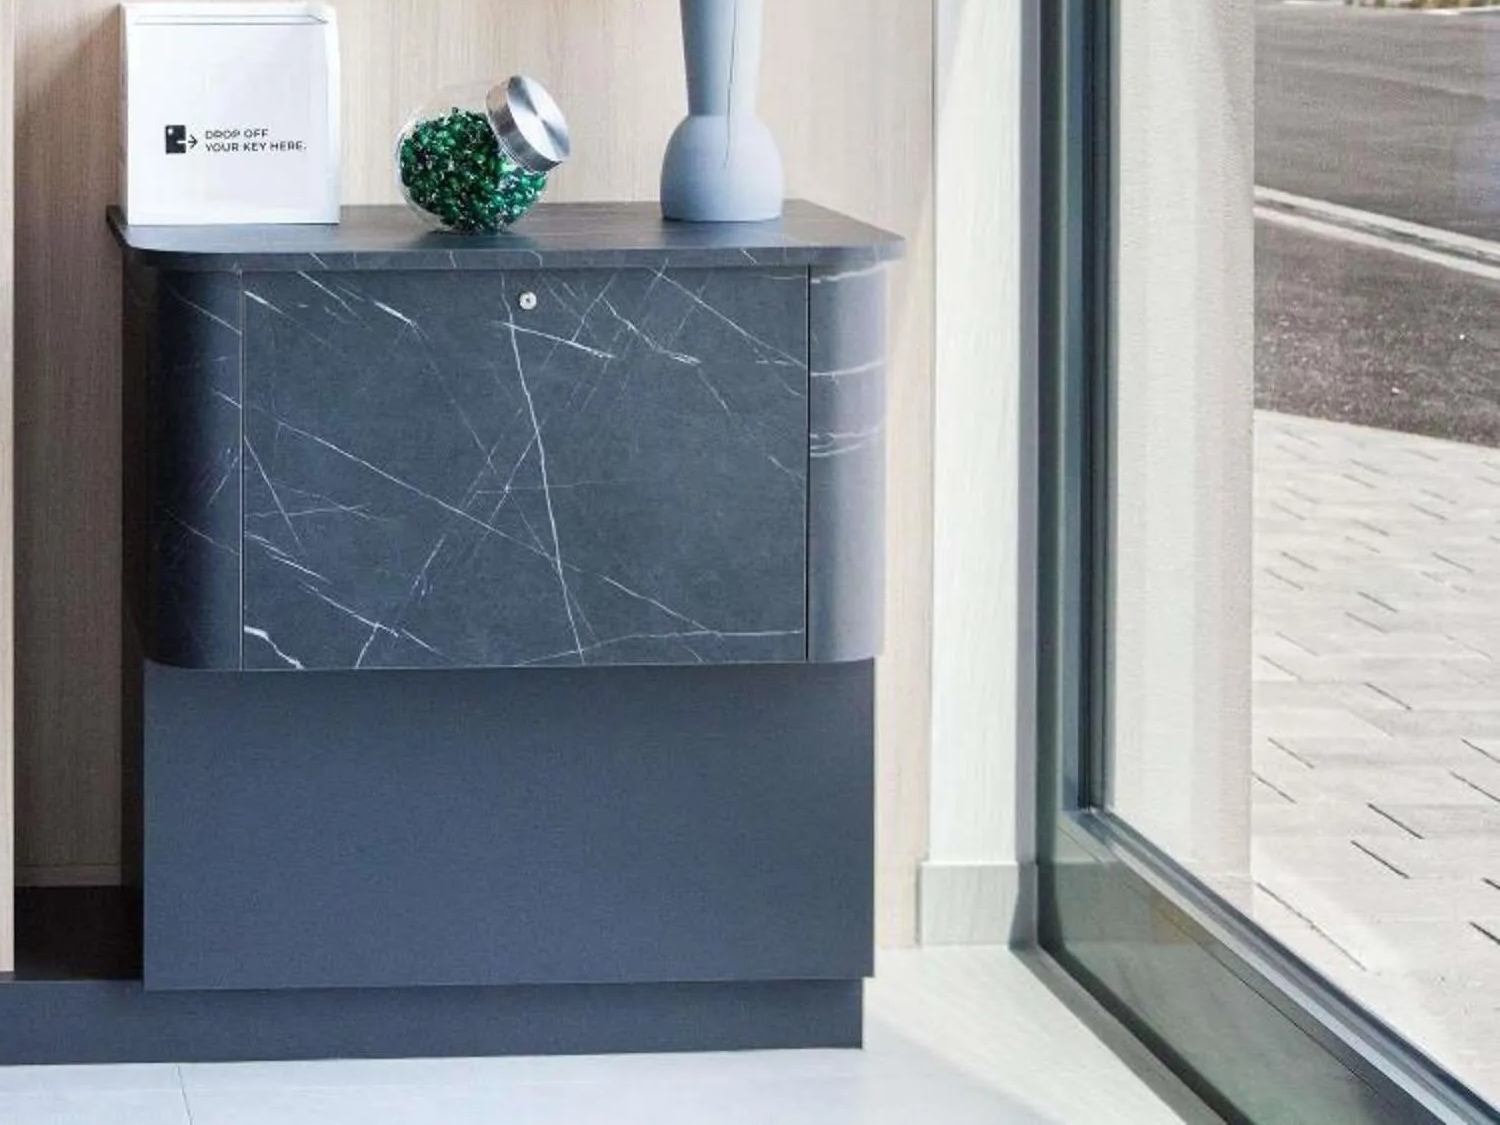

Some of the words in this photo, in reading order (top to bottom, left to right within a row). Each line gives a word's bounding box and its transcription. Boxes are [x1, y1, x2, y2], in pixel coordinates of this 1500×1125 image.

[205, 129, 240, 140] DROP
[243, 128, 269, 138] OFF
[205, 142, 239, 152] YOUR
[243, 142, 267, 152] KEY
[270, 140, 307, 151] HERE.
